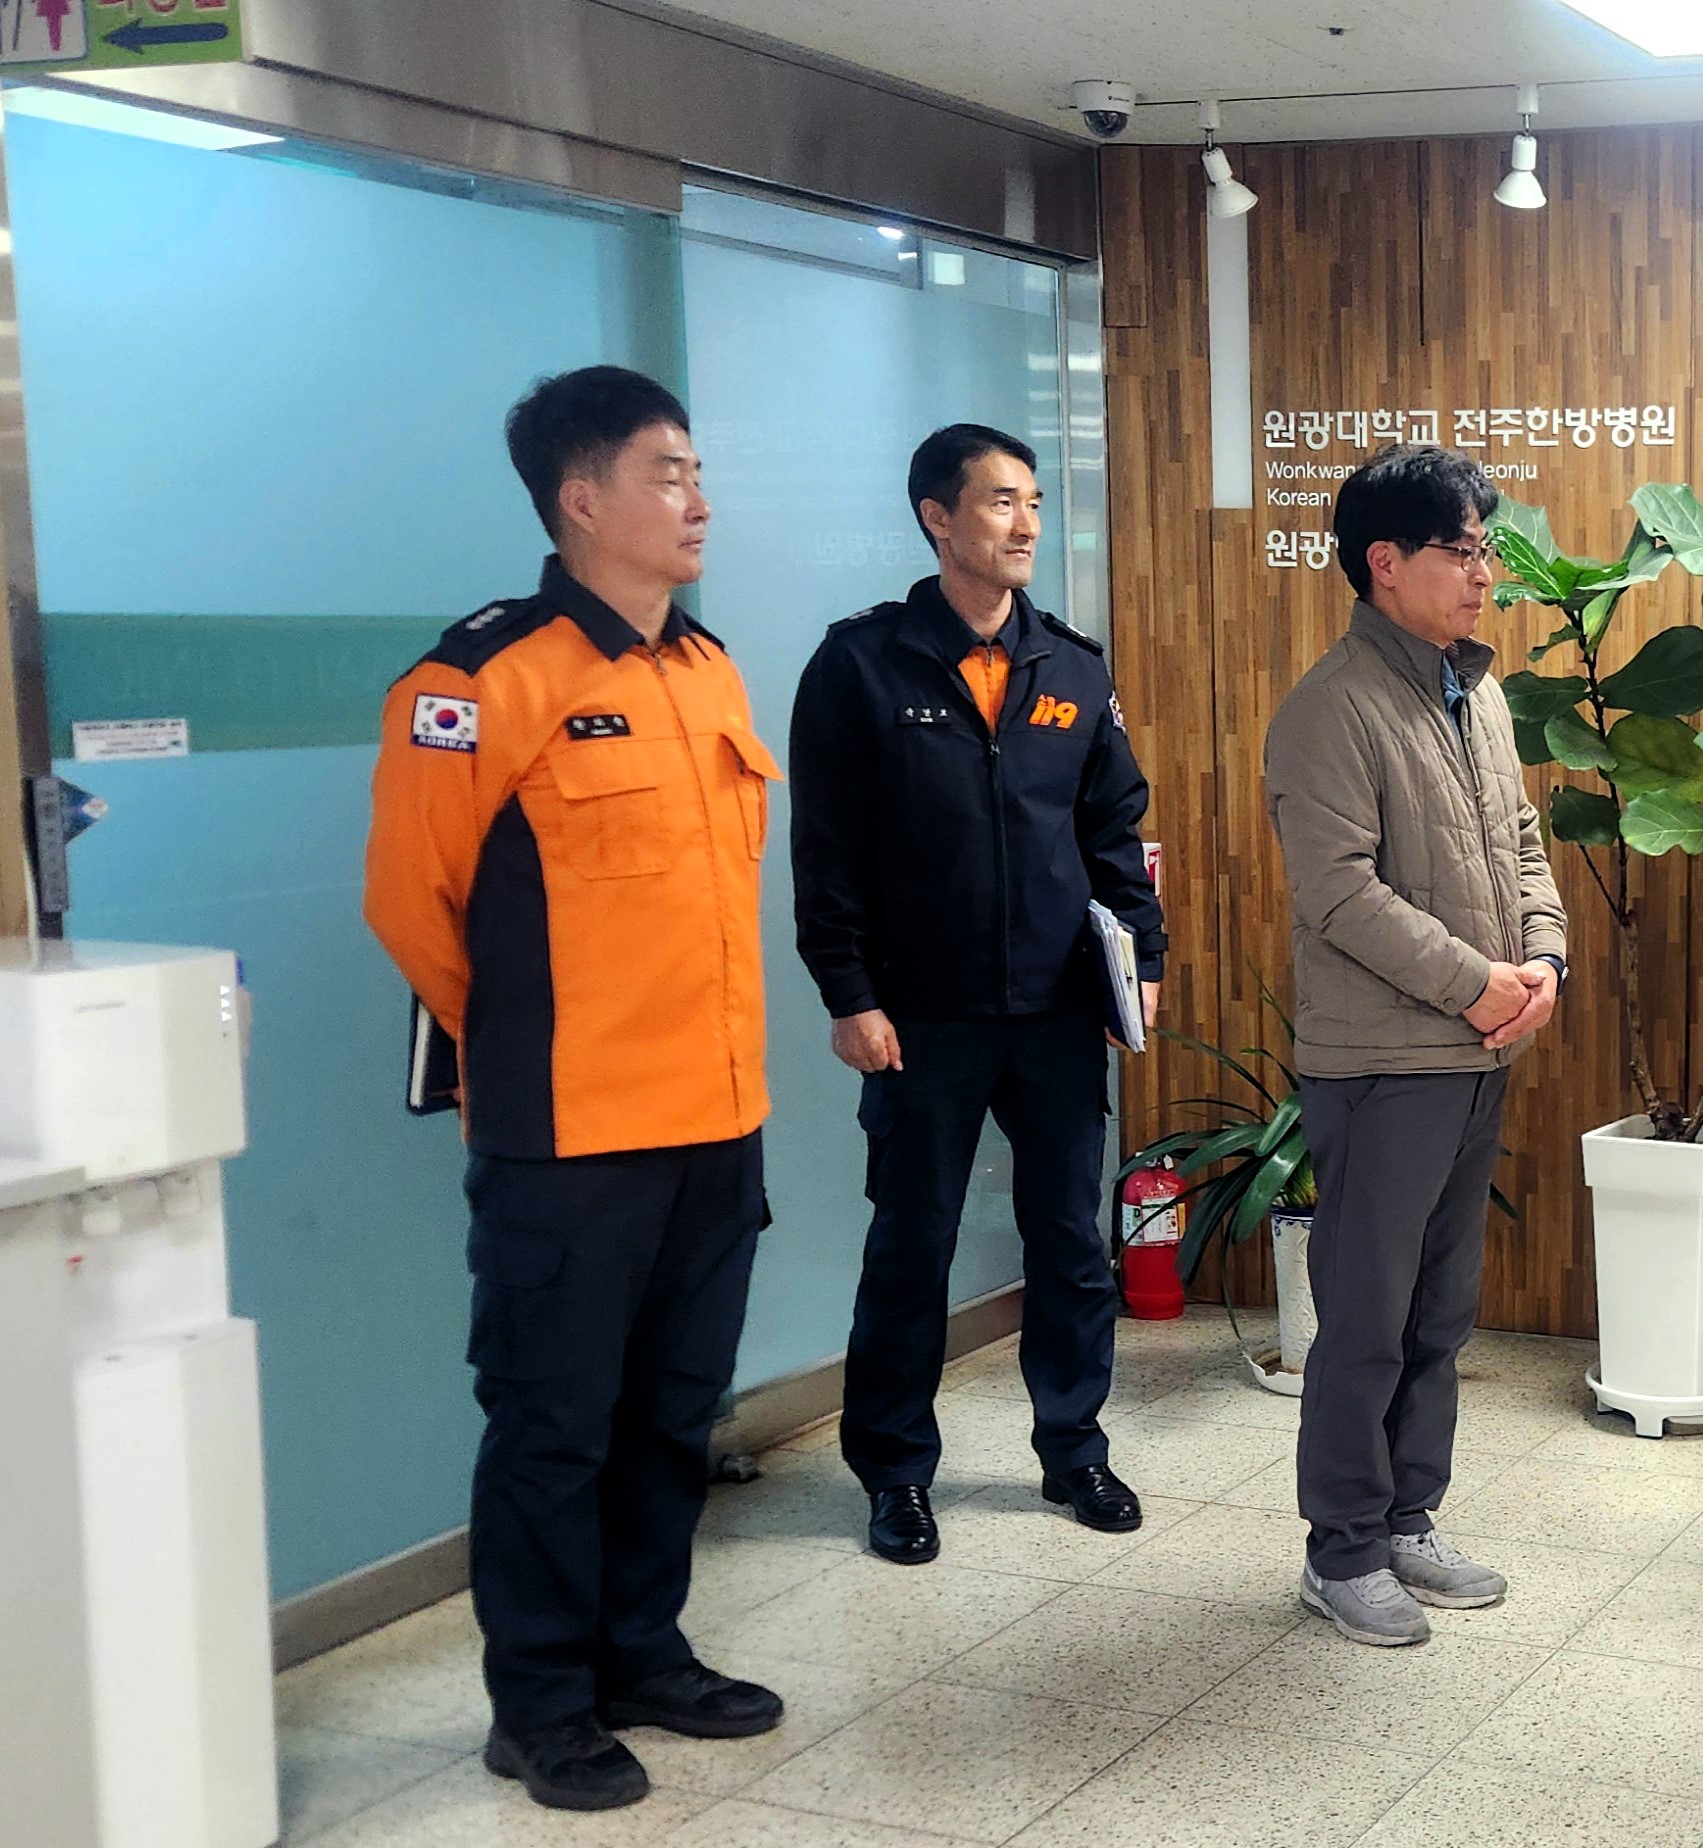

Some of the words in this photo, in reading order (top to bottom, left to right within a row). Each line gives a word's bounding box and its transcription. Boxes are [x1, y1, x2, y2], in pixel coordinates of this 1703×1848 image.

[1263, 408, 1441, 451] 원광대학교
[1453, 404, 1676, 449] 전주한방병원
[1265, 460, 1359, 480] Wonkwan
[1266, 487, 1332, 507] Korean
[1029, 693, 1080, 730] 119
